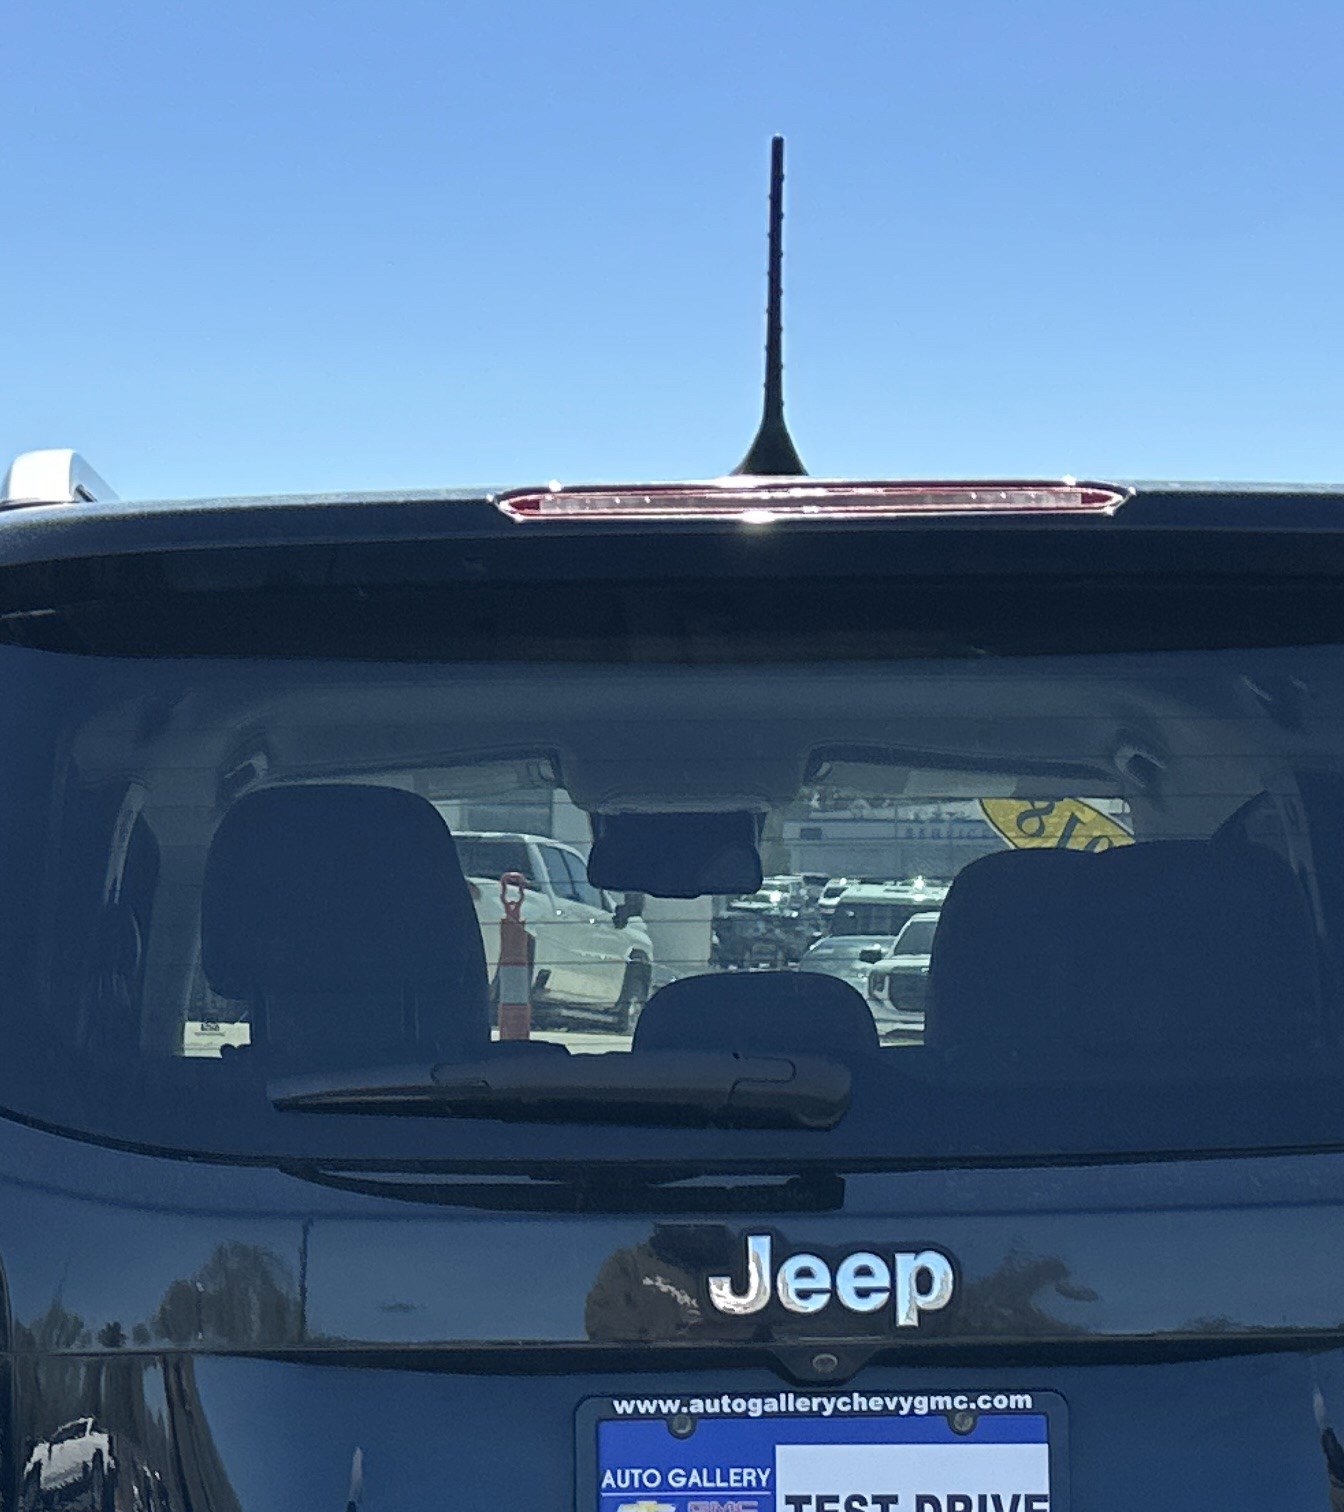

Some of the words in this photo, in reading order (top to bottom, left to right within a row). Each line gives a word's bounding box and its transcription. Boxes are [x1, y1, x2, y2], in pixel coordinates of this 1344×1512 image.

[708, 1235, 954, 1328] Jeep
[612, 1392, 1033, 1416] www.autogallerychevygmc.com
[601, 1468, 661, 1489] AUTO
[667, 1467, 772, 1488] GALLERY
